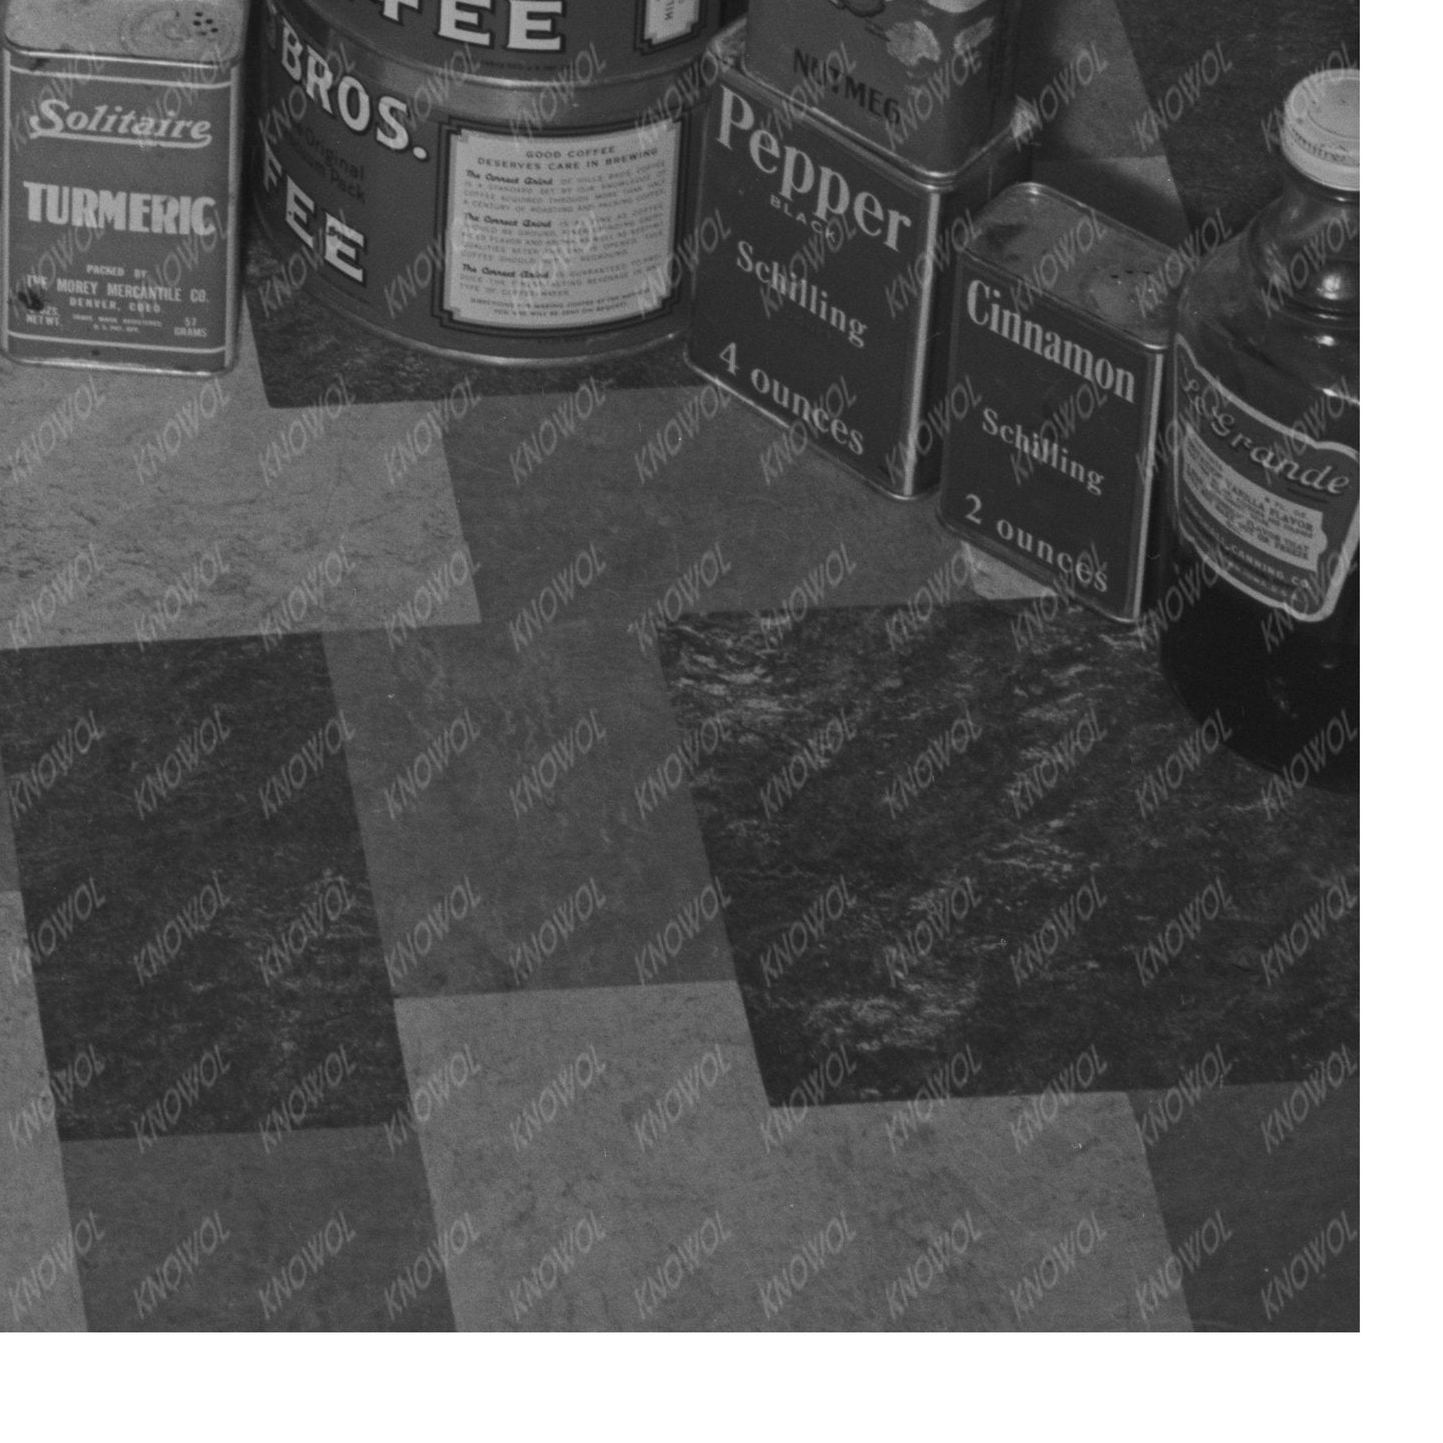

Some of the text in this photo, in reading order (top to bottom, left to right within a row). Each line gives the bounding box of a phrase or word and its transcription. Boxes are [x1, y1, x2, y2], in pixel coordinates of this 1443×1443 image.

[28, 97, 213, 151] Solitaire
[280, 16, 429, 160] BROS.
[477, 157, 542, 171] DESERVES
[525, 145, 616, 160] GOOD COFFEE
[716, 85, 913, 253] Pepper
[22, 180, 216, 237] TURMERIC
[769, 194, 837, 244] BLACK
[56, 277, 210, 303] MOREY MERCANTILE CO.
[735, 239, 869, 350] Schilling
[173, 326, 208, 338] GRAMS
[966, 277, 1136, 405] Cinnamon
[718, 341, 866, 458] 4 ounces
[980, 406, 1106, 498] Schilling
[963, 492, 1108, 595] 2 ounces
